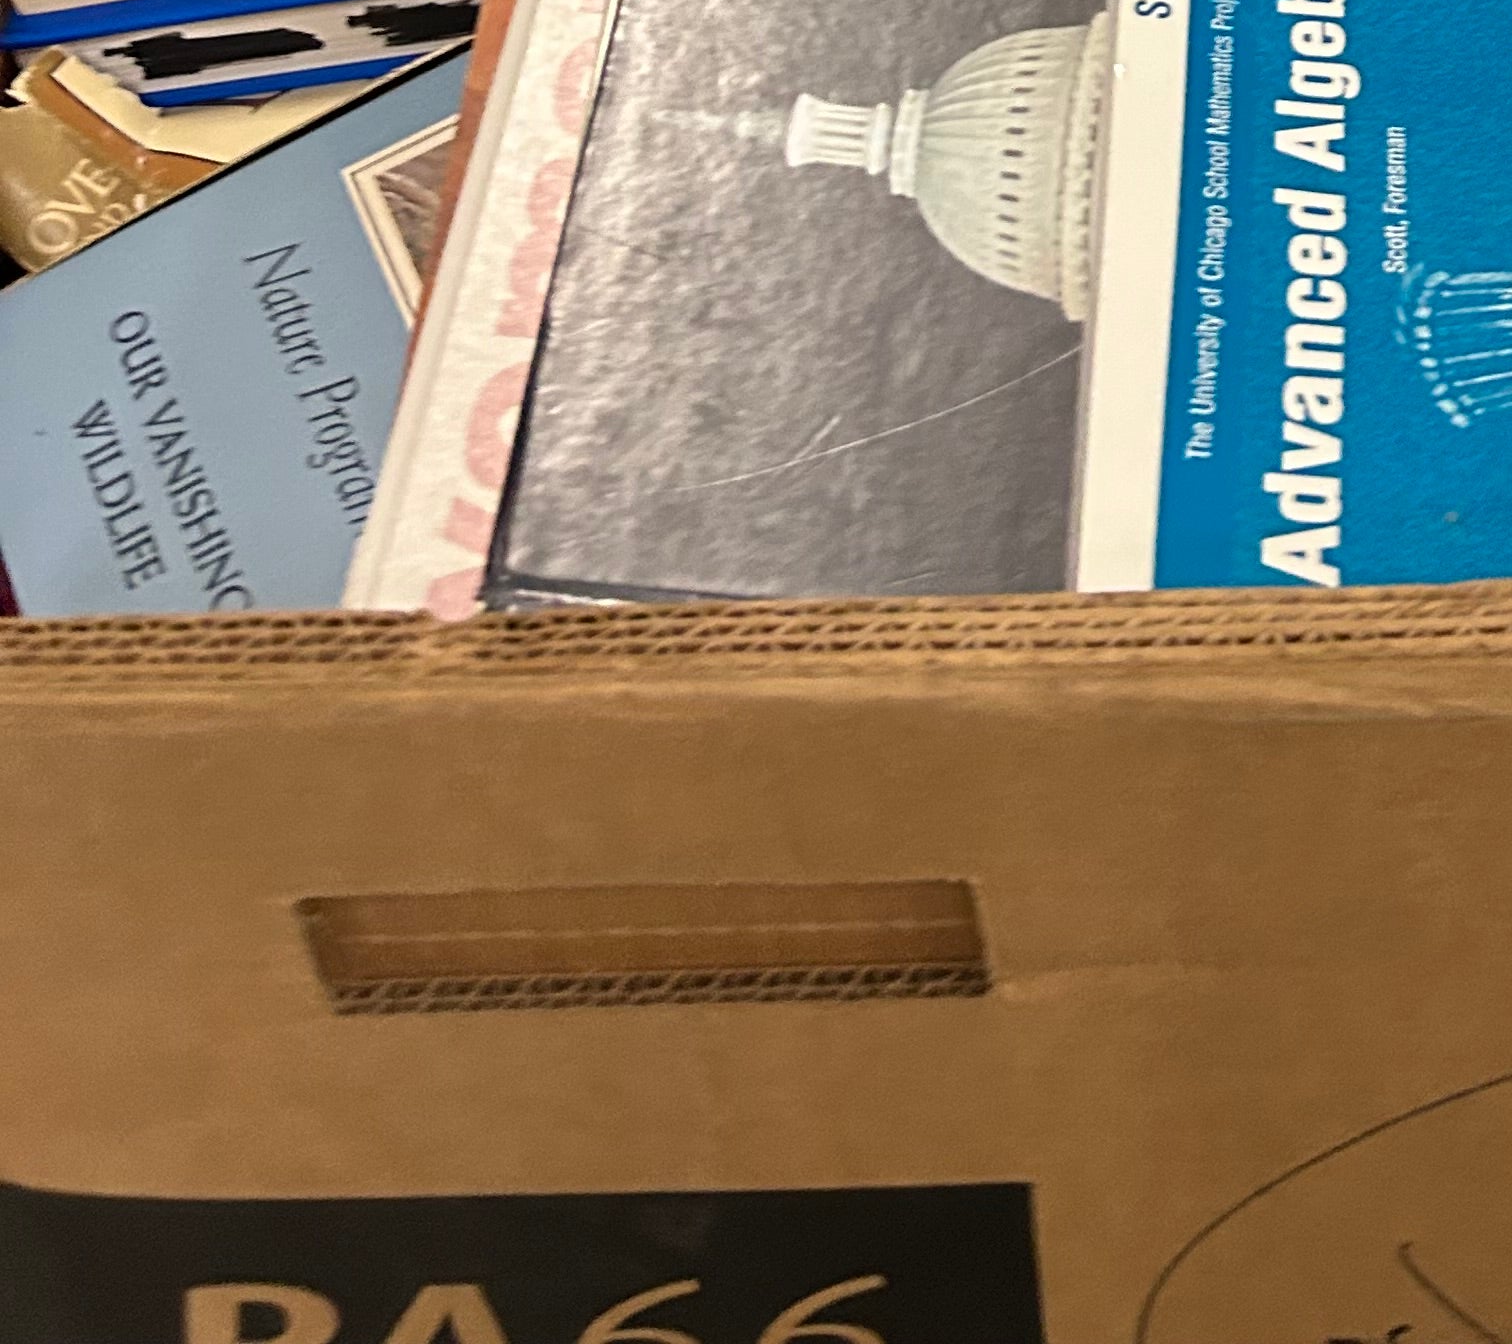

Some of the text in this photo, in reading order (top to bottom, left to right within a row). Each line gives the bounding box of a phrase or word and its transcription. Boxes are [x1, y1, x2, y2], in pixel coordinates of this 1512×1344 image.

[1205, 35, 1234, 136] Mathematics
[1203, 141, 1231, 201] School
[1382, 126, 1409, 274] Scott, Foresman
[1198, 205, 1232, 281] Chicago
[243, 242, 325, 375] Nature
[1200, 288, 1223, 309] of
[109, 312, 164, 399] OUR
[1189, 314, 1225, 415] University
[1259, 187, 1349, 587] Advanced
[1185, 422, 1213, 460] The
[71, 398, 165, 590] WILDLIFE
